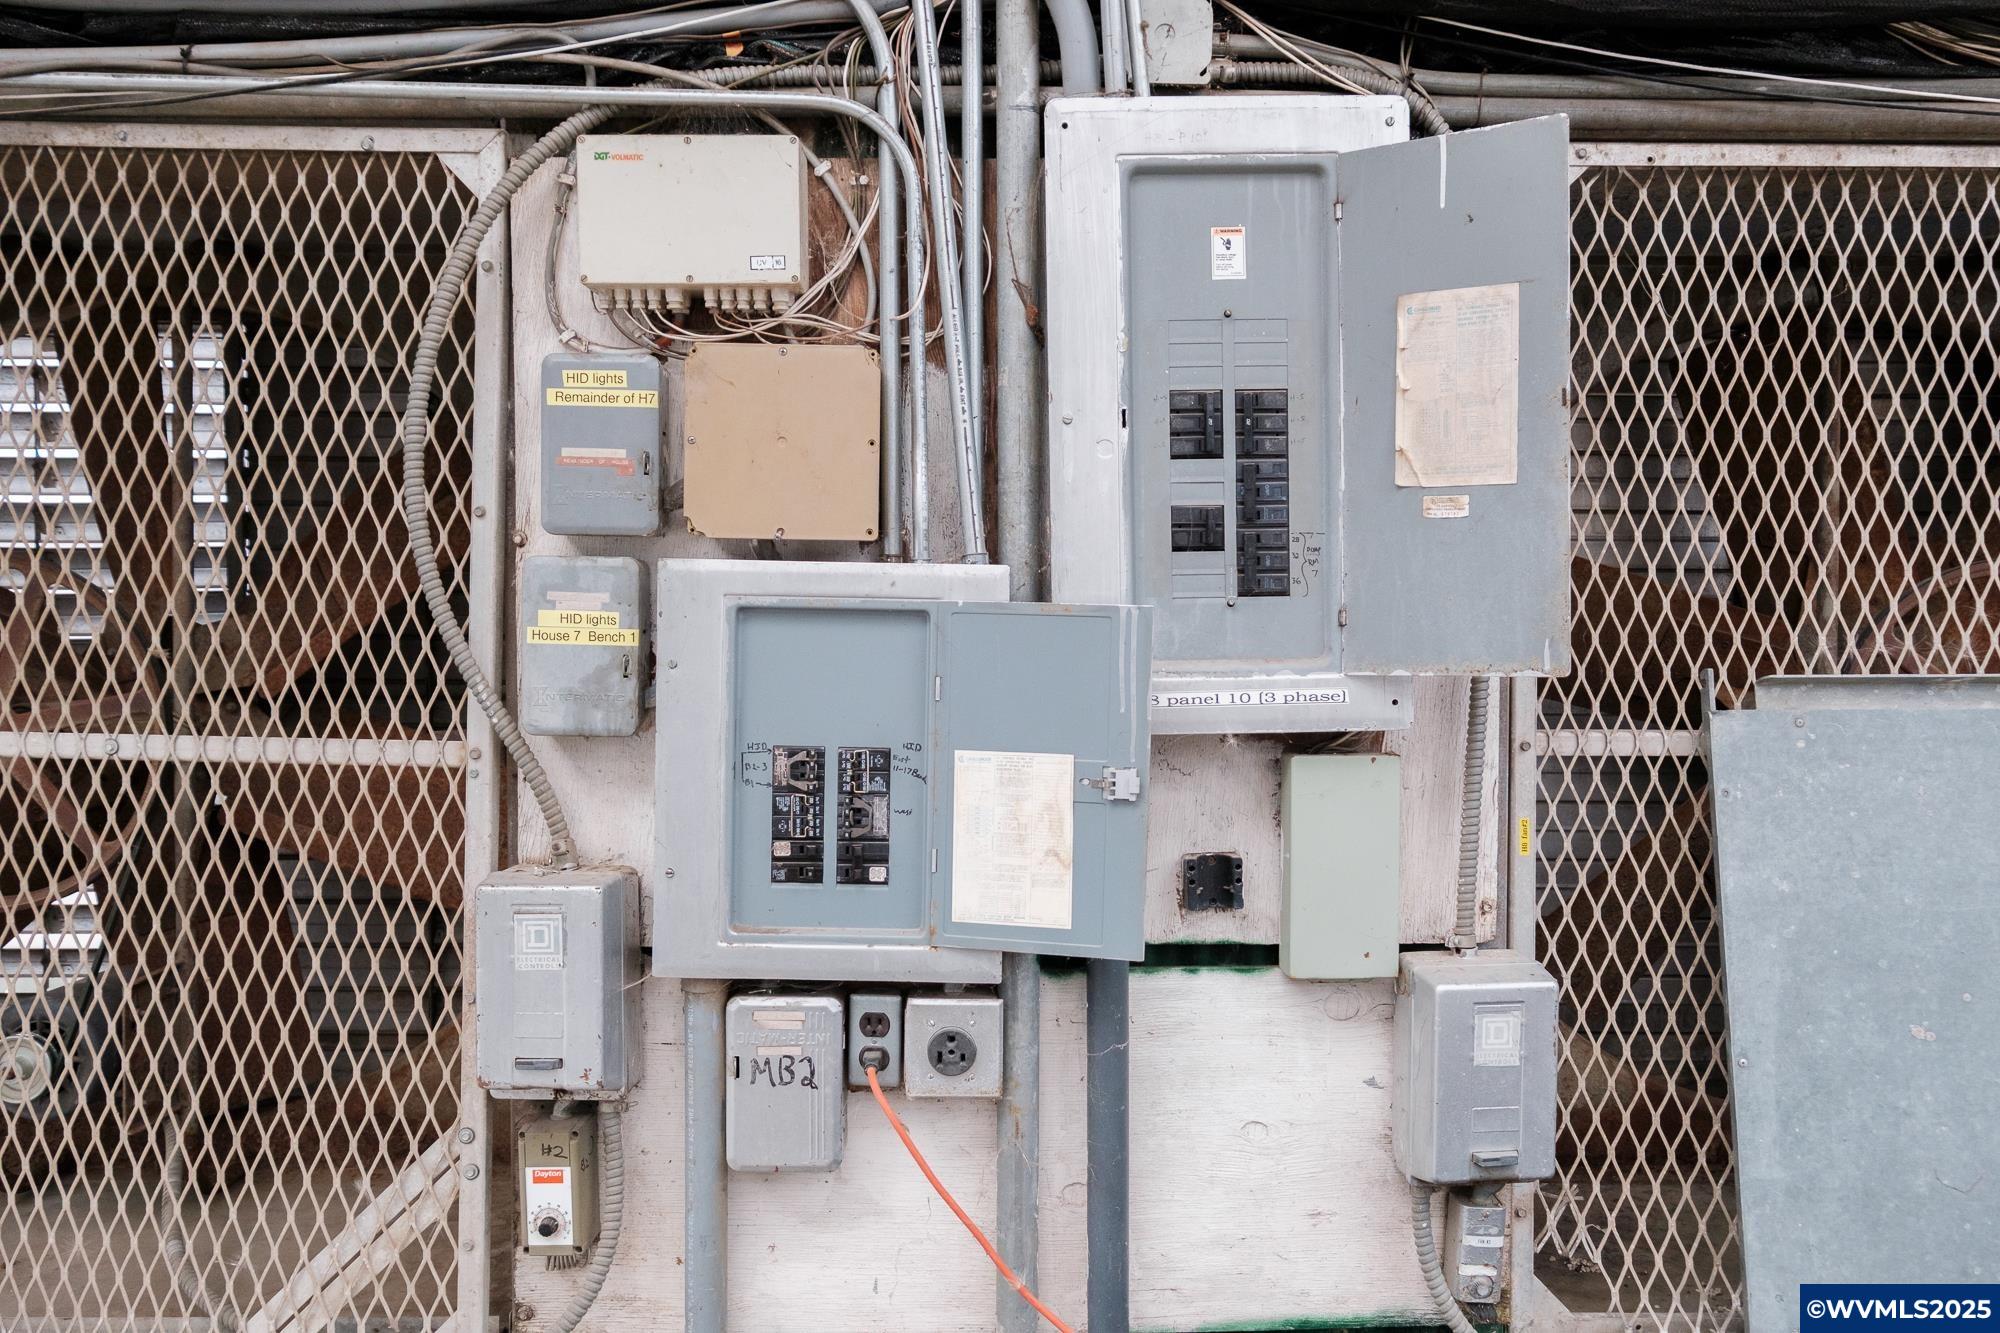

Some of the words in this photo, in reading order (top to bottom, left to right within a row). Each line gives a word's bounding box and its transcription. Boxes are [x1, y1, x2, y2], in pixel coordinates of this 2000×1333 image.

[566, 373, 588, 383] HID
[593, 373, 624, 385] lights
[555, 391, 619, 403] Remainder
[623, 393, 635, 404] of
[638, 393, 656, 404] H7
[560, 613, 582, 625] HID
[586, 614, 617, 627] lights
[532, 629, 570, 641] House
[574, 630, 581, 641] 7
[588, 631, 626, 642] Bench
[630, 632, 636, 642] 1
[1168, 692, 1219, 707] panel
[1229, 692, 1250, 704] 10
[750, 1055, 818, 1090] MB2
[534, 1170, 562, 1179] Dayton
